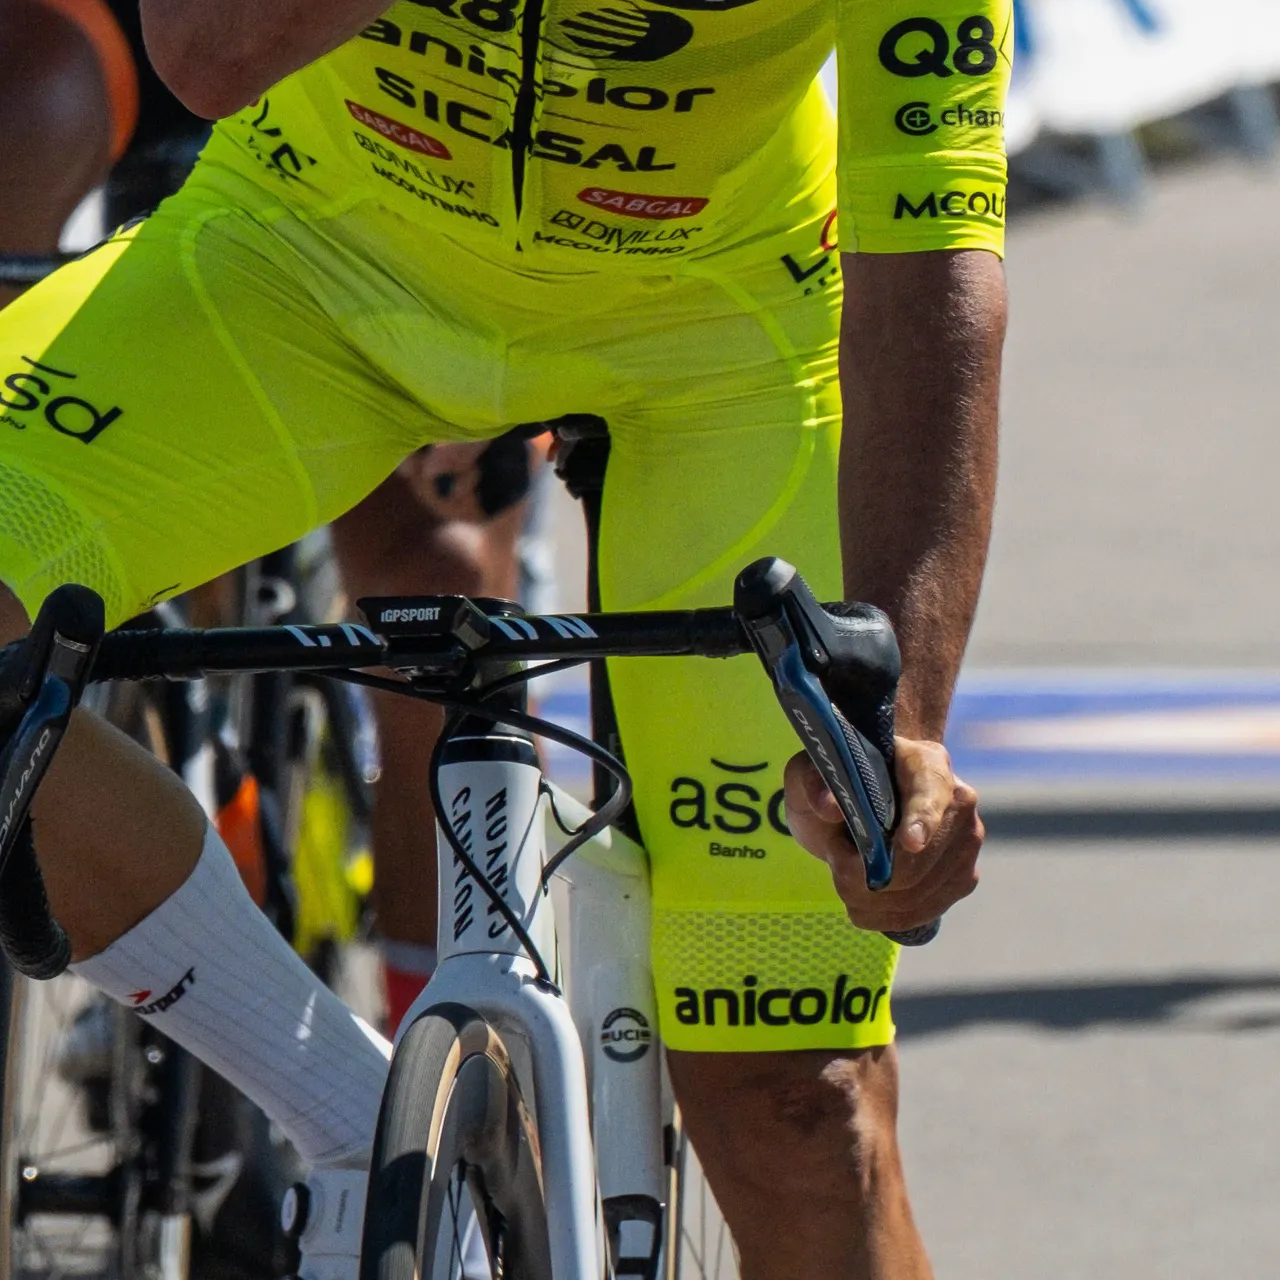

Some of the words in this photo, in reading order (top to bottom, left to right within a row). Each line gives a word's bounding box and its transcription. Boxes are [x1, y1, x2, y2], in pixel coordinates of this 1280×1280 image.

[878, 15, 998, 78] Q8
[940, 103, 1004, 128] chan
[586, 190, 693, 215] SABGAL
[709, 842, 766, 860] Banho
[674, 974, 888, 1027] anicolor
[612, 1029, 639, 1042] UCI
